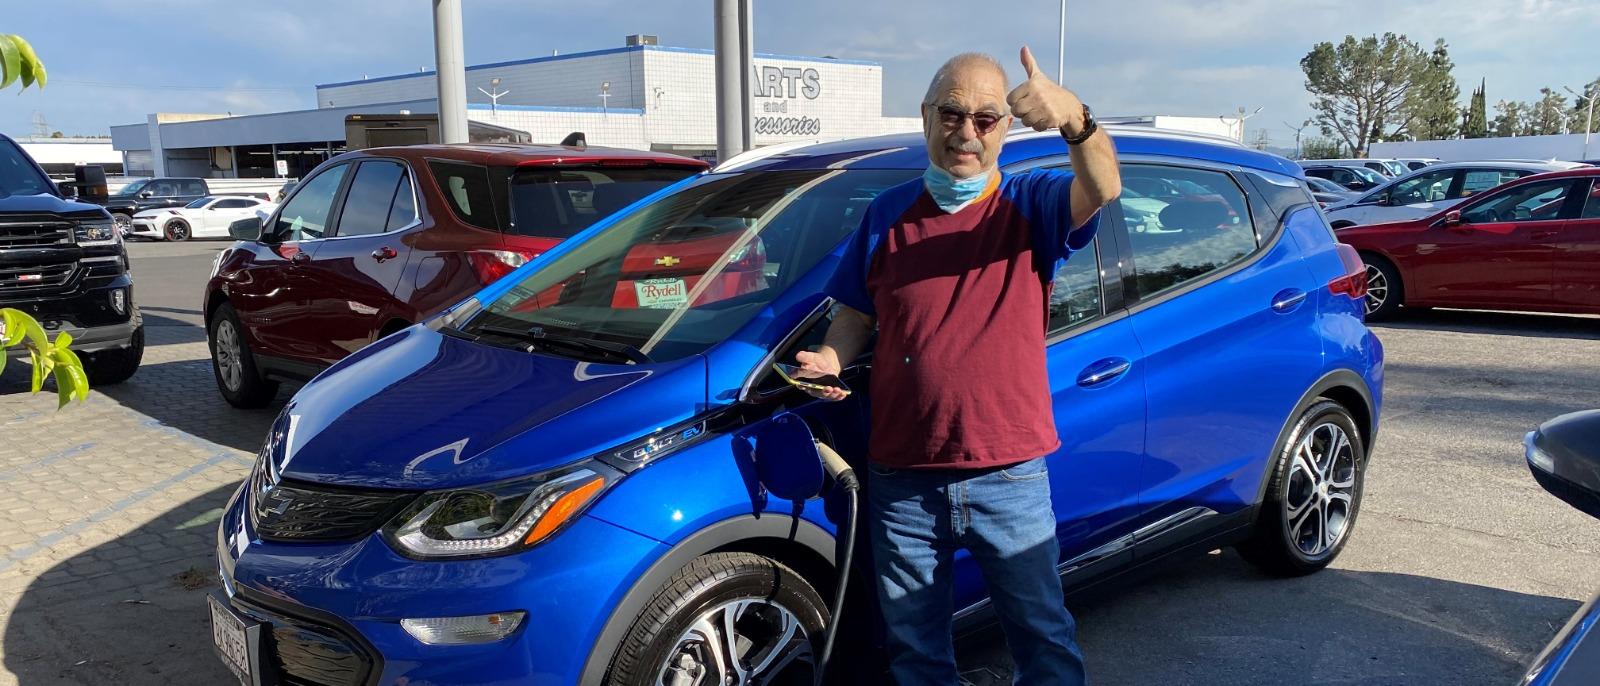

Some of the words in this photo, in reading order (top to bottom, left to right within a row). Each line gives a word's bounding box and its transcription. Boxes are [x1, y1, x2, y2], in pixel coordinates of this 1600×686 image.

[763, 100, 788, 113] and
[642, 284, 681, 300] Rydell
[682, 425, 701, 439] EV
